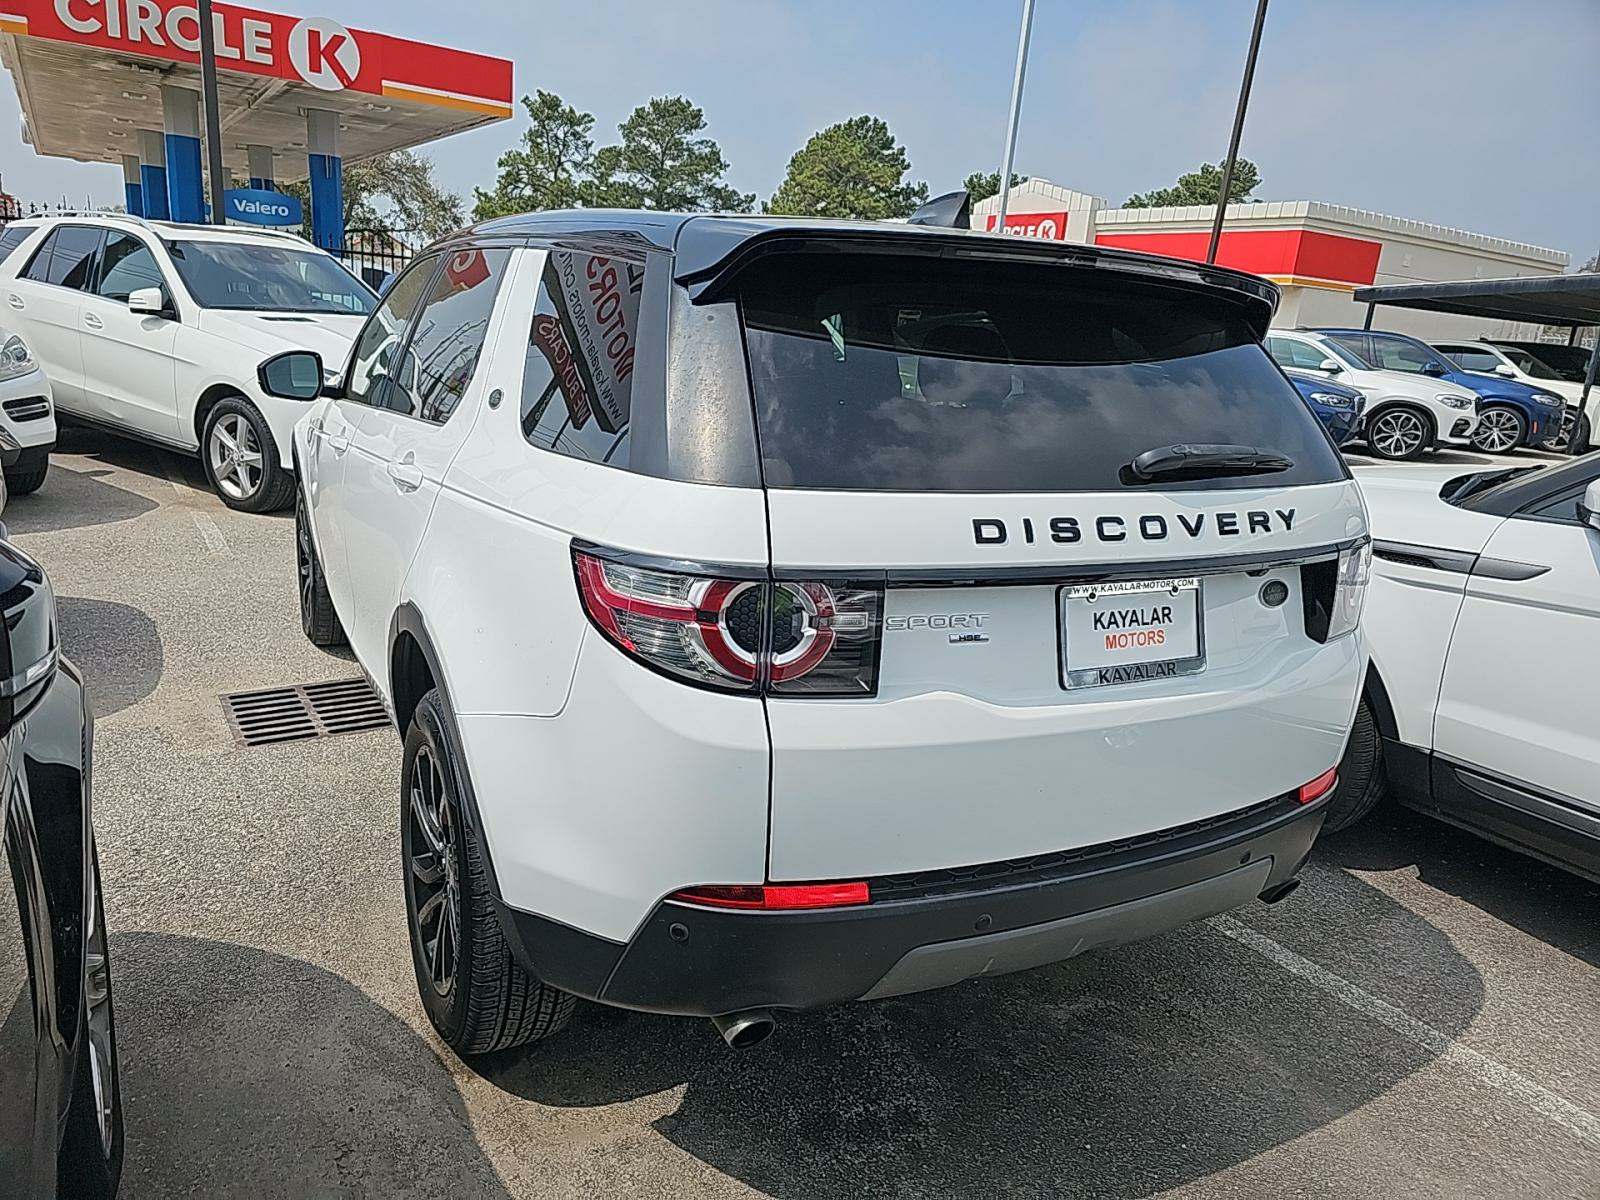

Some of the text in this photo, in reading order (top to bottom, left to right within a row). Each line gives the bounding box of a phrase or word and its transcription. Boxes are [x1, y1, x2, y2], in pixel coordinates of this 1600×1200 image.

[54, 0, 356, 88] CIRCLE K
[233, 198, 289, 217] Valero
[972, 508, 1296, 545] DISCOVERY
[1072, 579, 1194, 595] WWW.KAYALAR-MOTORS.COM
[885, 612, 992, 631] SPORT
[1093, 606, 1173, 631] KAYALAR
[957, 634, 981, 642] HSE
[1105, 629, 1165, 650] MOTORS
[1099, 662, 1177, 684] KAYALAR
